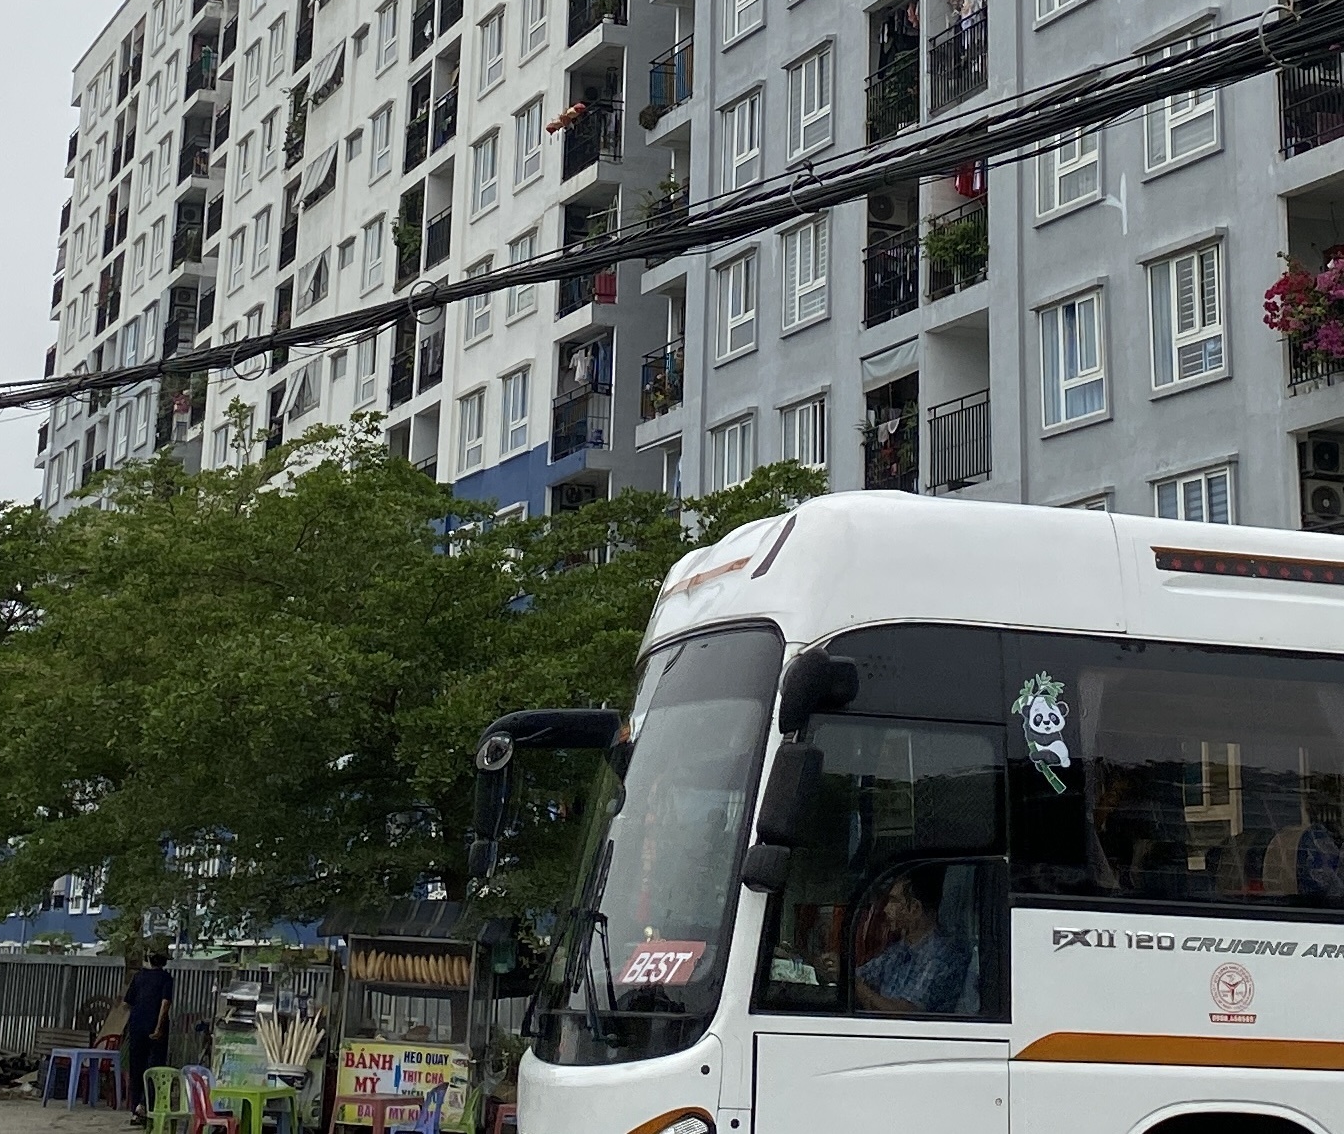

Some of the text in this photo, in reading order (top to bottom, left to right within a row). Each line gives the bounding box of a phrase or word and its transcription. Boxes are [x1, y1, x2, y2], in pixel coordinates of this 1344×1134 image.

[1125, 930, 1175, 951] 120
[1181, 935, 1299, 957] CRUISING
[622, 951, 693, 984] BEST
[403, 1050, 449, 1066] HEO QUAY
